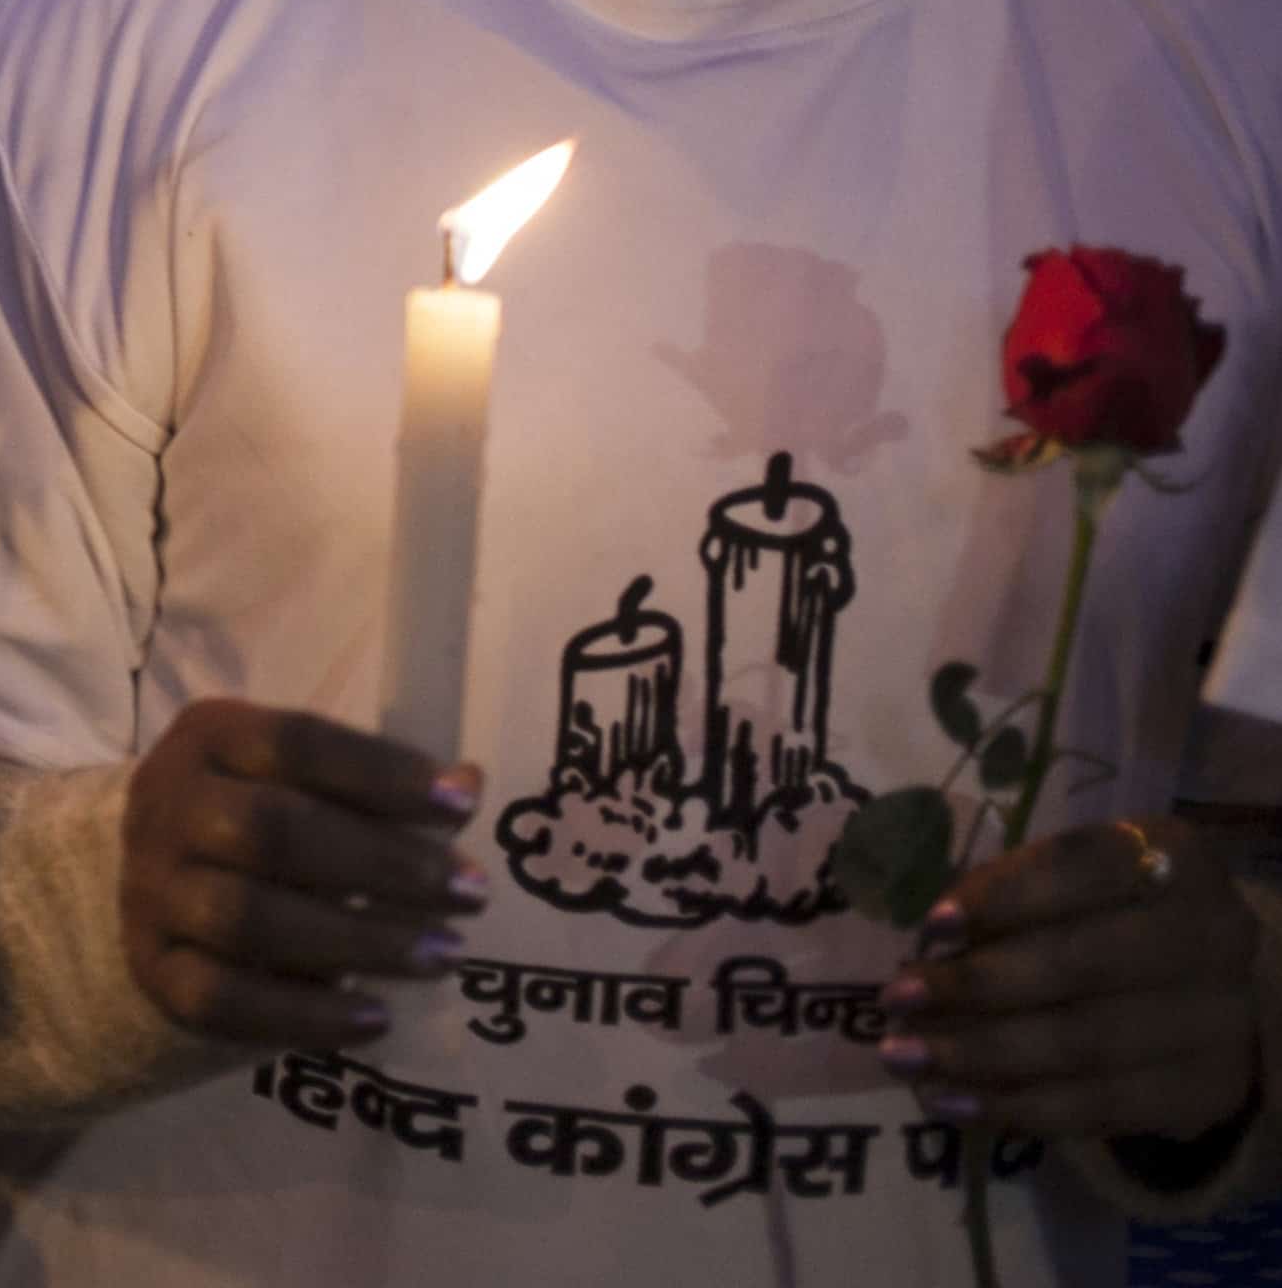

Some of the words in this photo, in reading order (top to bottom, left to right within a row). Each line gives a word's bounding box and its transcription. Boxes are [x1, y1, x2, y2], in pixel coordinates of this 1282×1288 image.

[458, 958, 691, 1044] चुनाव
[712, 956, 889, 1042] चिन्ह
[504, 1084, 881, 1208] कांग्रेस
